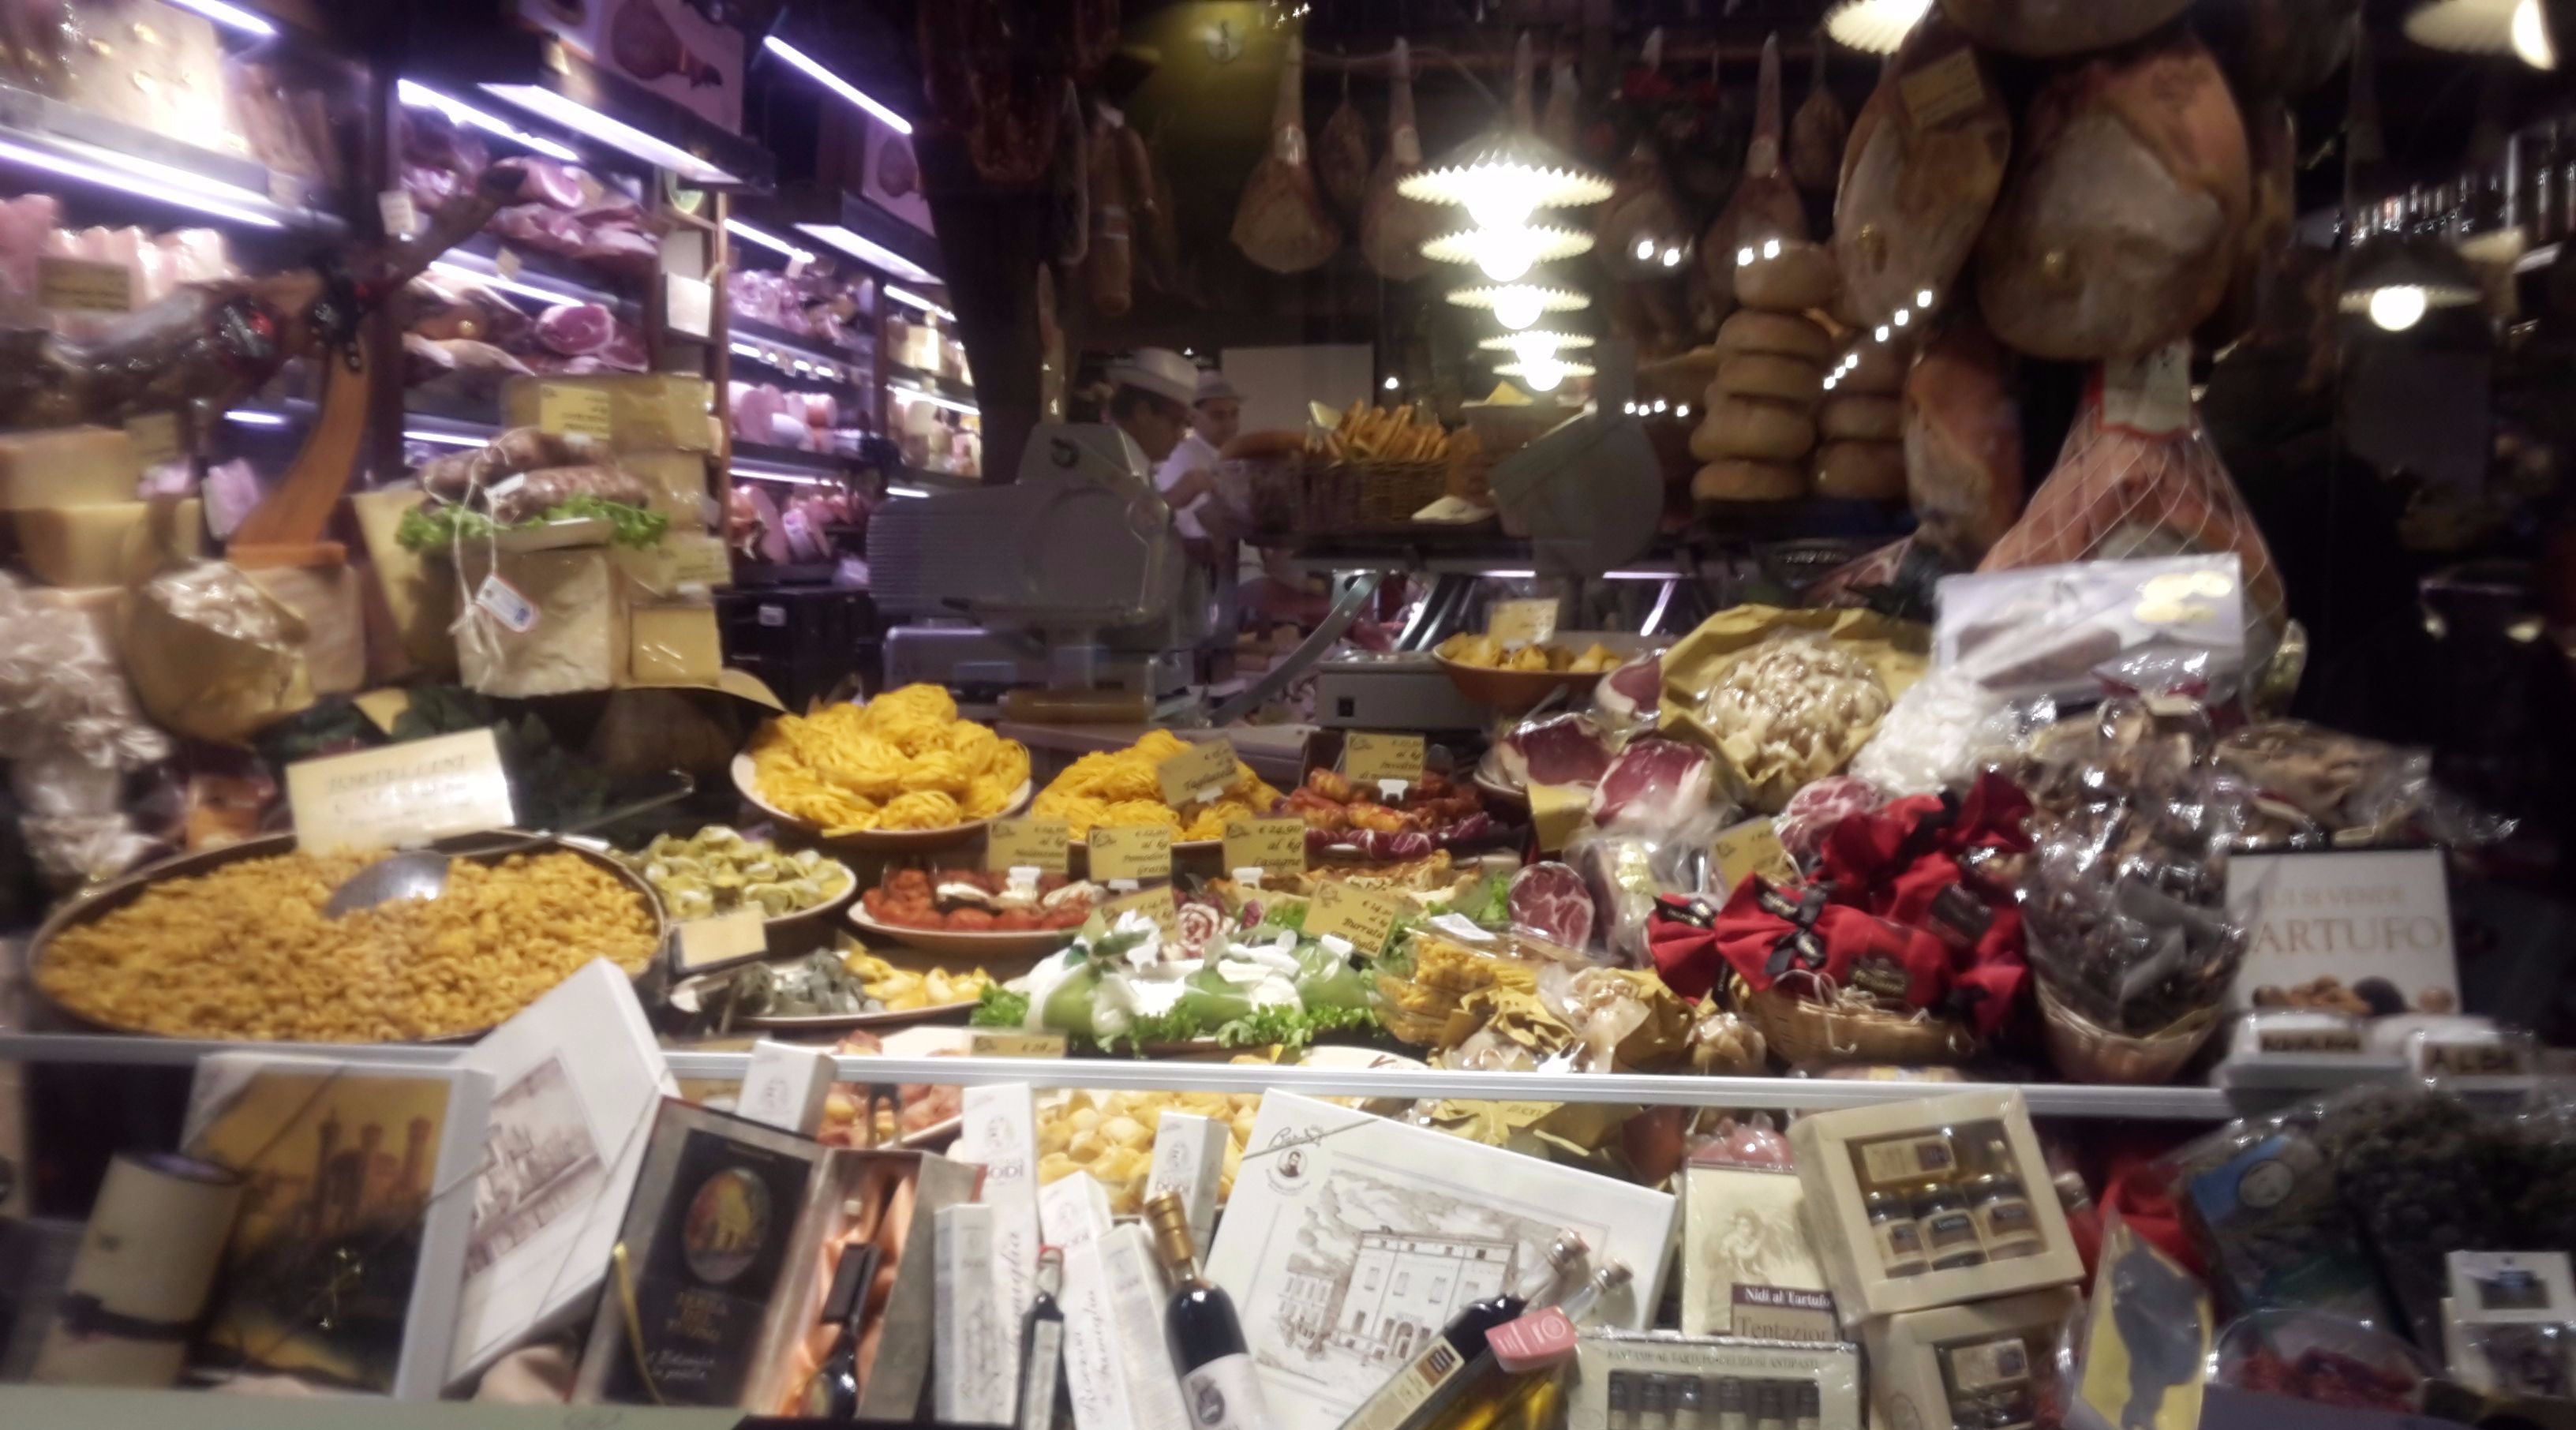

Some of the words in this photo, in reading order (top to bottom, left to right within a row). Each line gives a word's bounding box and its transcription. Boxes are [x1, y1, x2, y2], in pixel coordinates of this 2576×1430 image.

[2255, 915, 2445, 954] ARTUFO
[1744, 1286, 1769, 1303] Nidi
[1772, 1290, 1783, 1303] al
[1788, 1291, 1830, 1307] Tartufo
